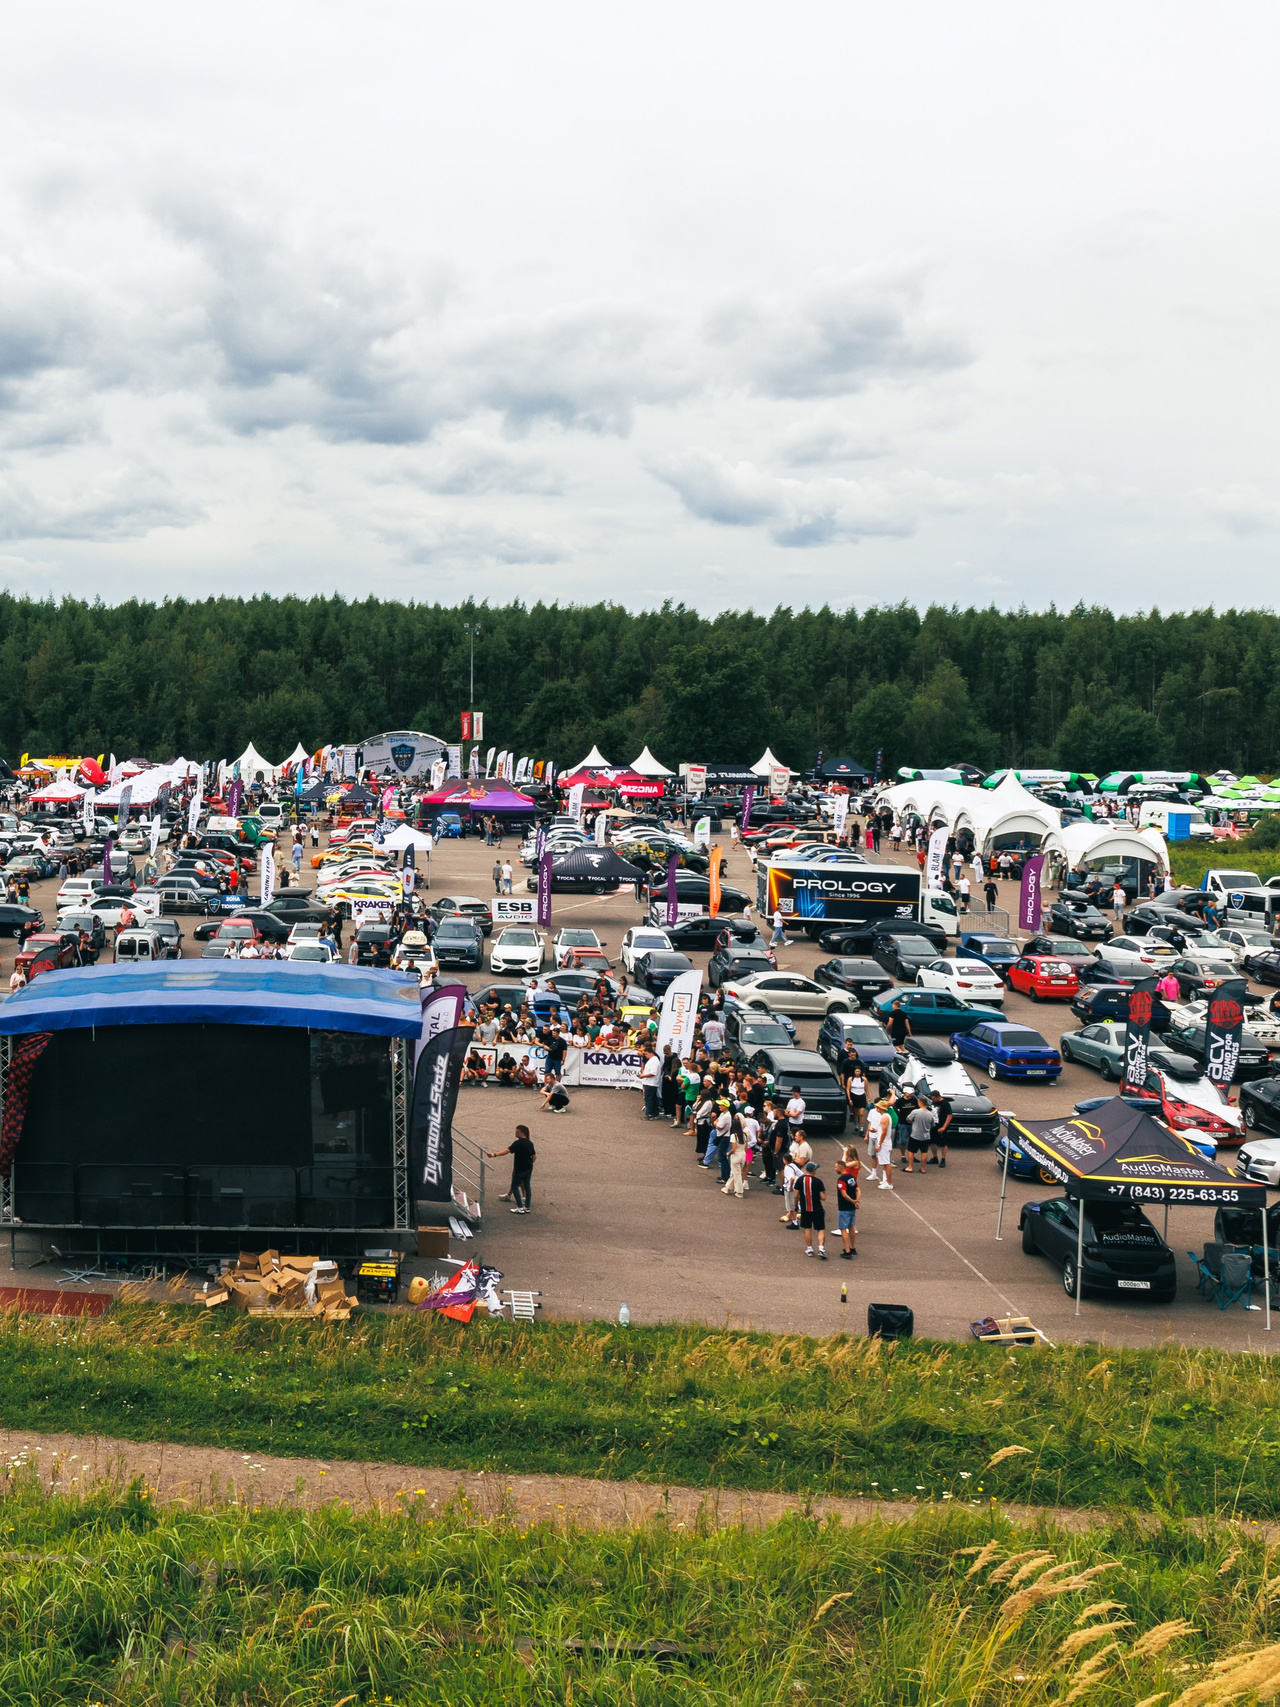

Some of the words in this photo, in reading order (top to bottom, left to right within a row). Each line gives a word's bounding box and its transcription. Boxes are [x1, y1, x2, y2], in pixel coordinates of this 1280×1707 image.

[931, 853, 941, 891] BLAM
[792, 878, 897, 894] PROLOGY
[353, 900, 394, 908] KRAKEN
[1027, 868, 1037, 924] PROLOGY
[498, 902, 532, 911] ESB
[1225, 1033, 1233, 1051] FOR
[583, 1051, 642, 1067] KRAKE
[1121, 1162, 1205, 1177] AudioMaster
[1108, 1185, 1125, 1196] +7
[1129, 1185, 1165, 1201] (843)
[1169, 1188, 1239, 1202] 225-63-55
[1102, 1233, 1155, 1243] AudioMaster
